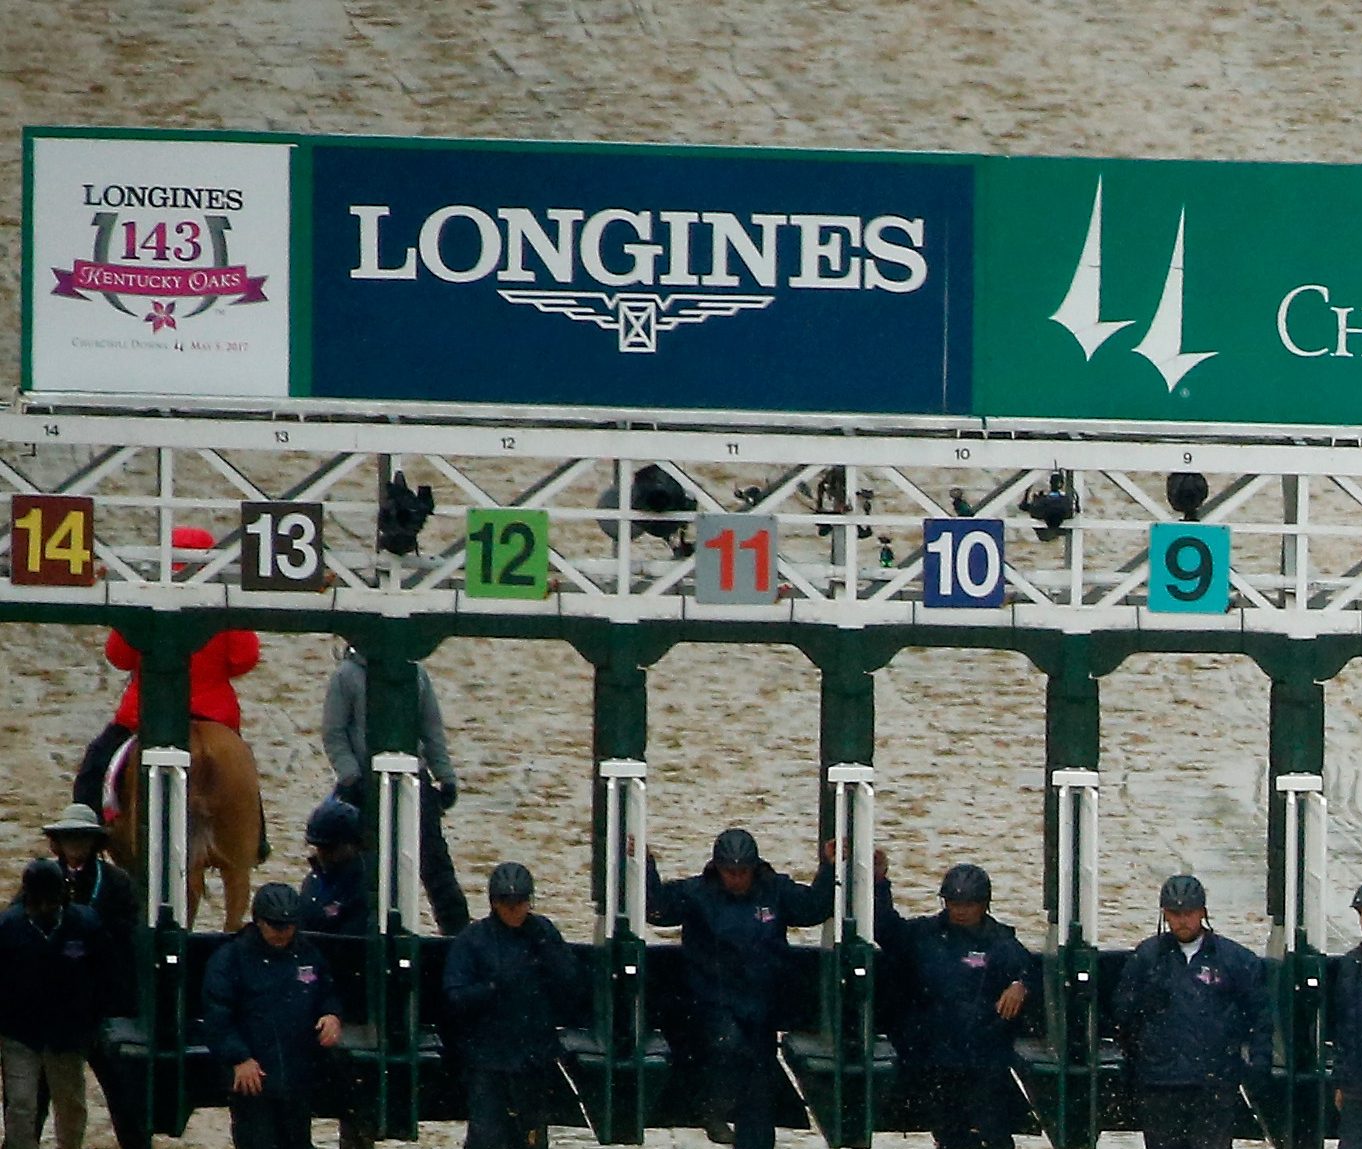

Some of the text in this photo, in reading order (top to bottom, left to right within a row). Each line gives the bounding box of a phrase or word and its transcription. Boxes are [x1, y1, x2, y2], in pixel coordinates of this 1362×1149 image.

[83, 184, 244, 211] LONGINES
[121, 221, 202, 262] 143
[349, 205, 928, 293] LONGINES
[80, 266, 242, 291] KENTUCKY OAKS
[44, 425, 59, 436] 14
[275, 432, 289, 442] 13
[501, 437, 515, 449] 12
[727, 444, 738, 454] 11
[955, 448, 970, 459] 10
[1184, 452, 1192, 464] 9
[15, 508, 91, 575] 14
[246, 512, 319, 580] 13
[468, 522, 536, 586] 12
[704, 529, 770, 592] 11
[926, 529, 1001, 598] 10
[1163, 536, 1214, 602] 9
